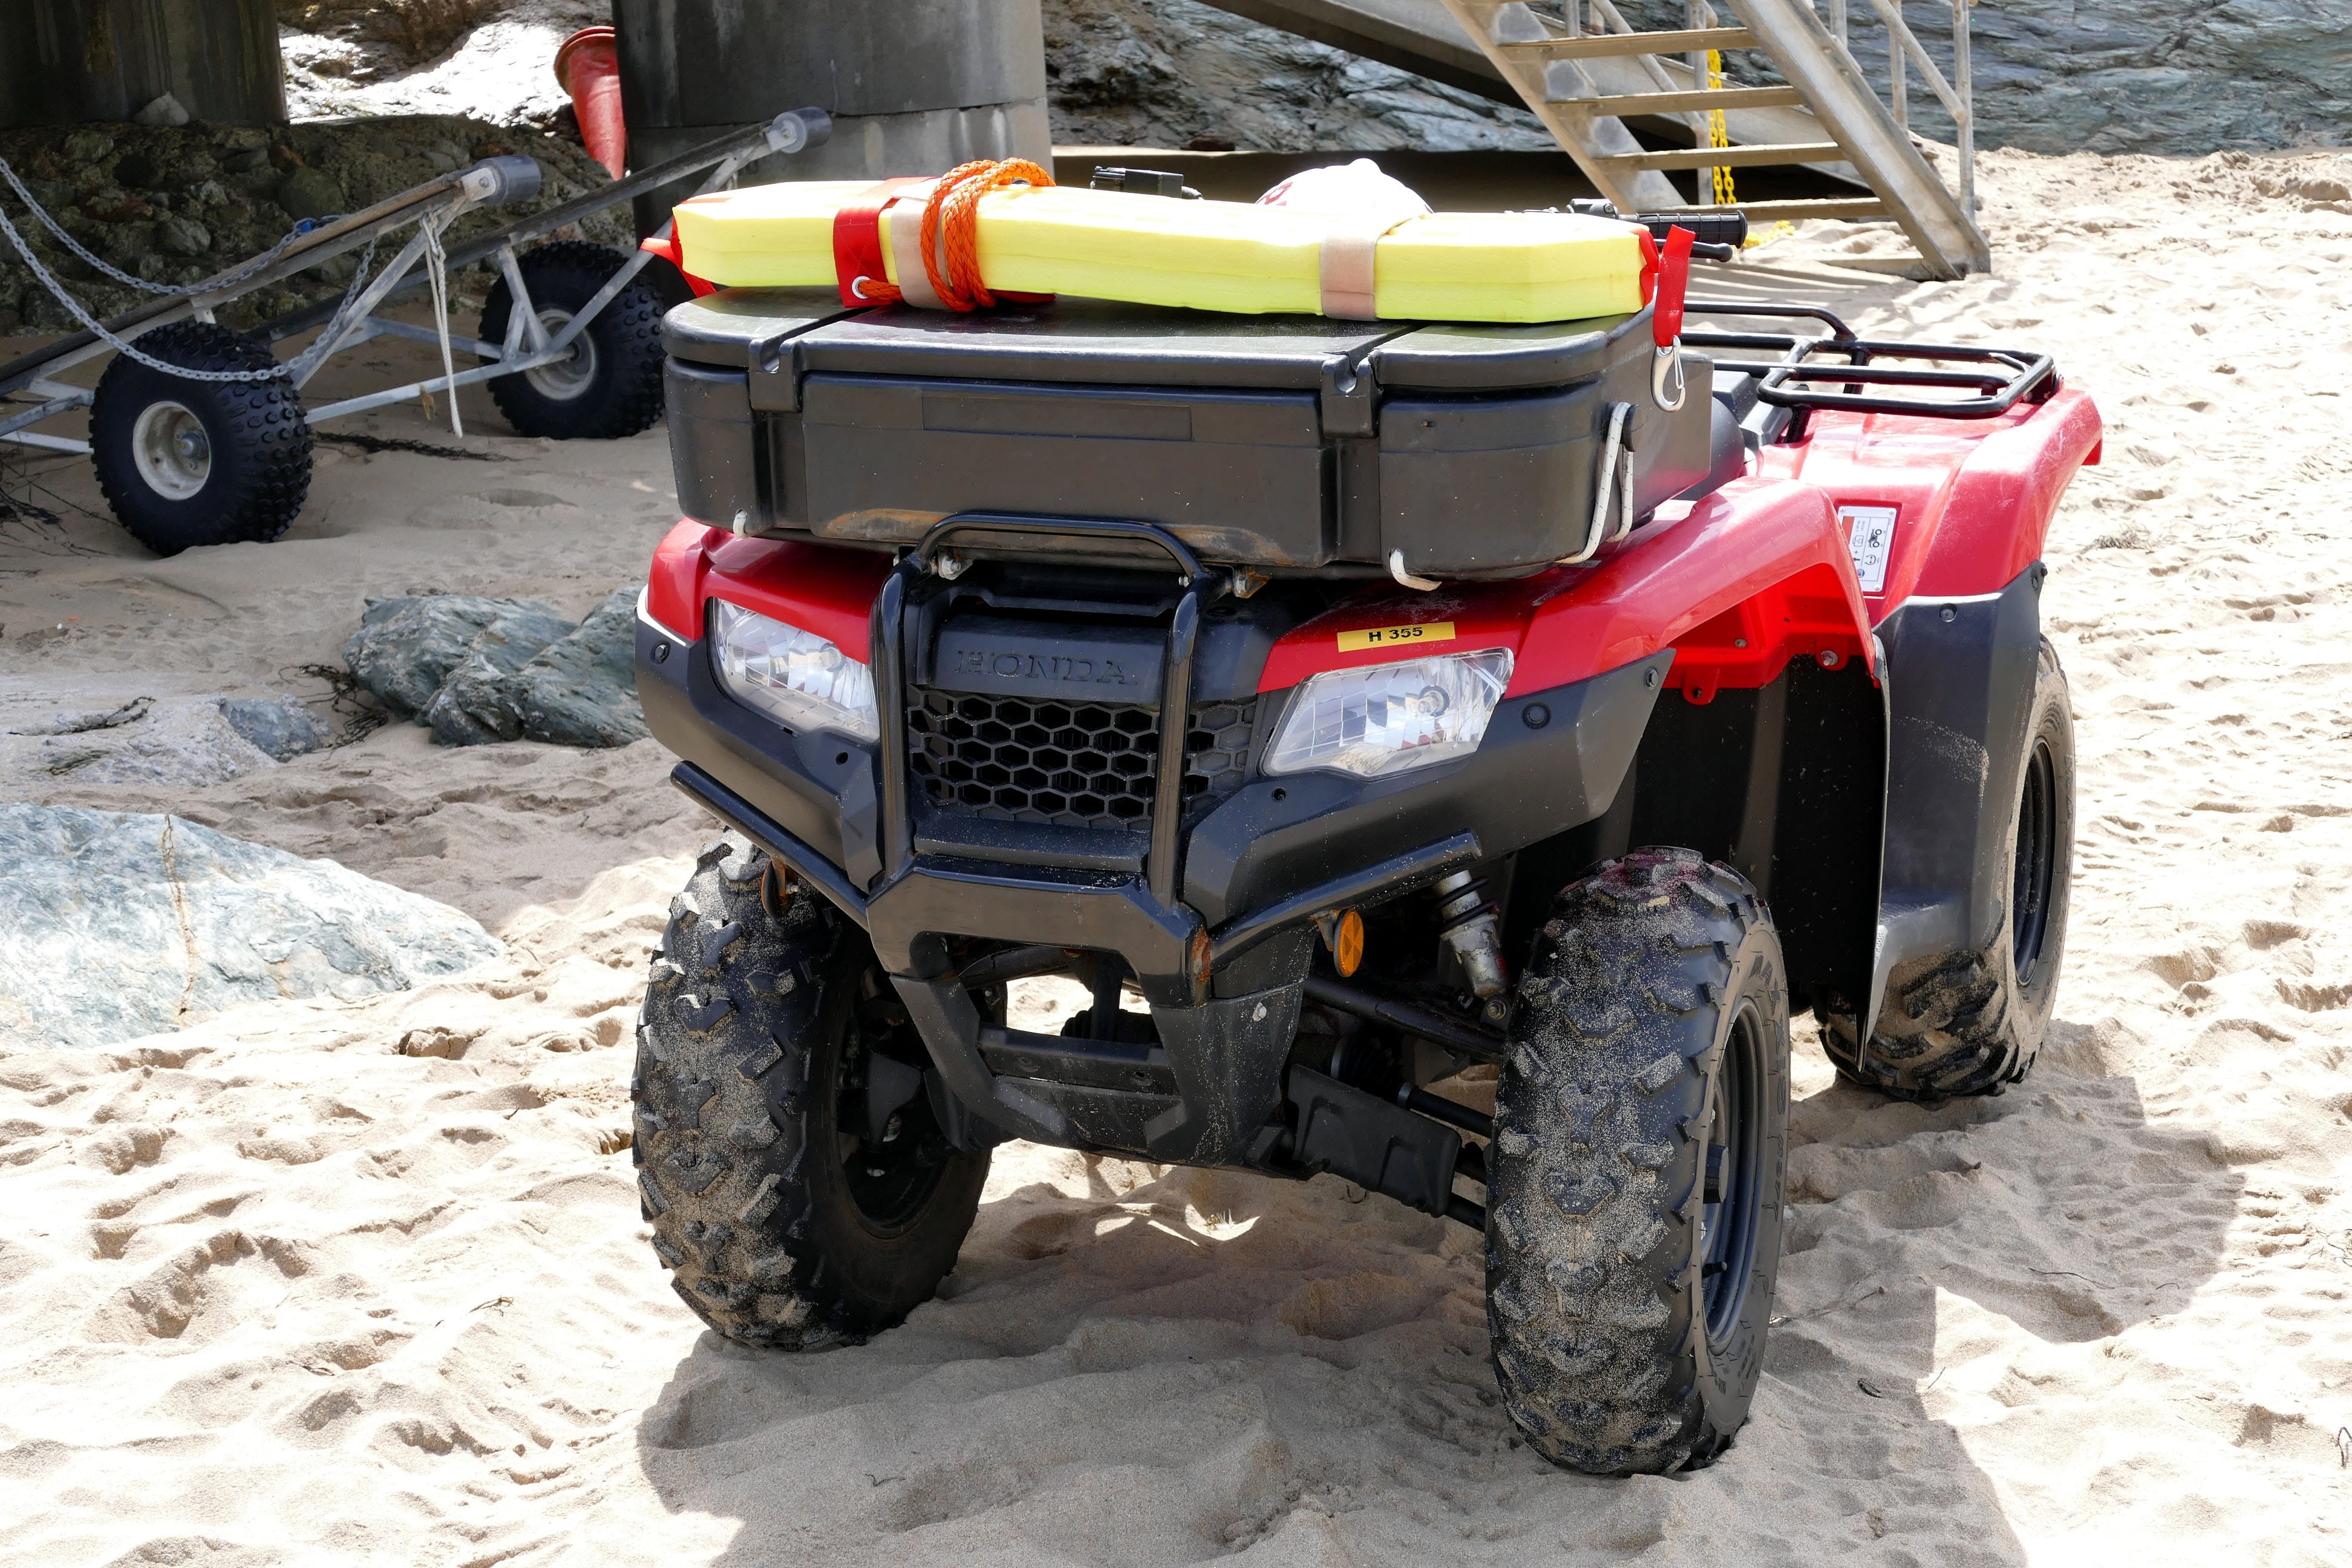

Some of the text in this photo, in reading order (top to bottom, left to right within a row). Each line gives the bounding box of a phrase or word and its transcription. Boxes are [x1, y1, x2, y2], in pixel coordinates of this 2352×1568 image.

[1368, 627, 1423, 642] H 355
[953, 650, 1138, 685] HONDA
